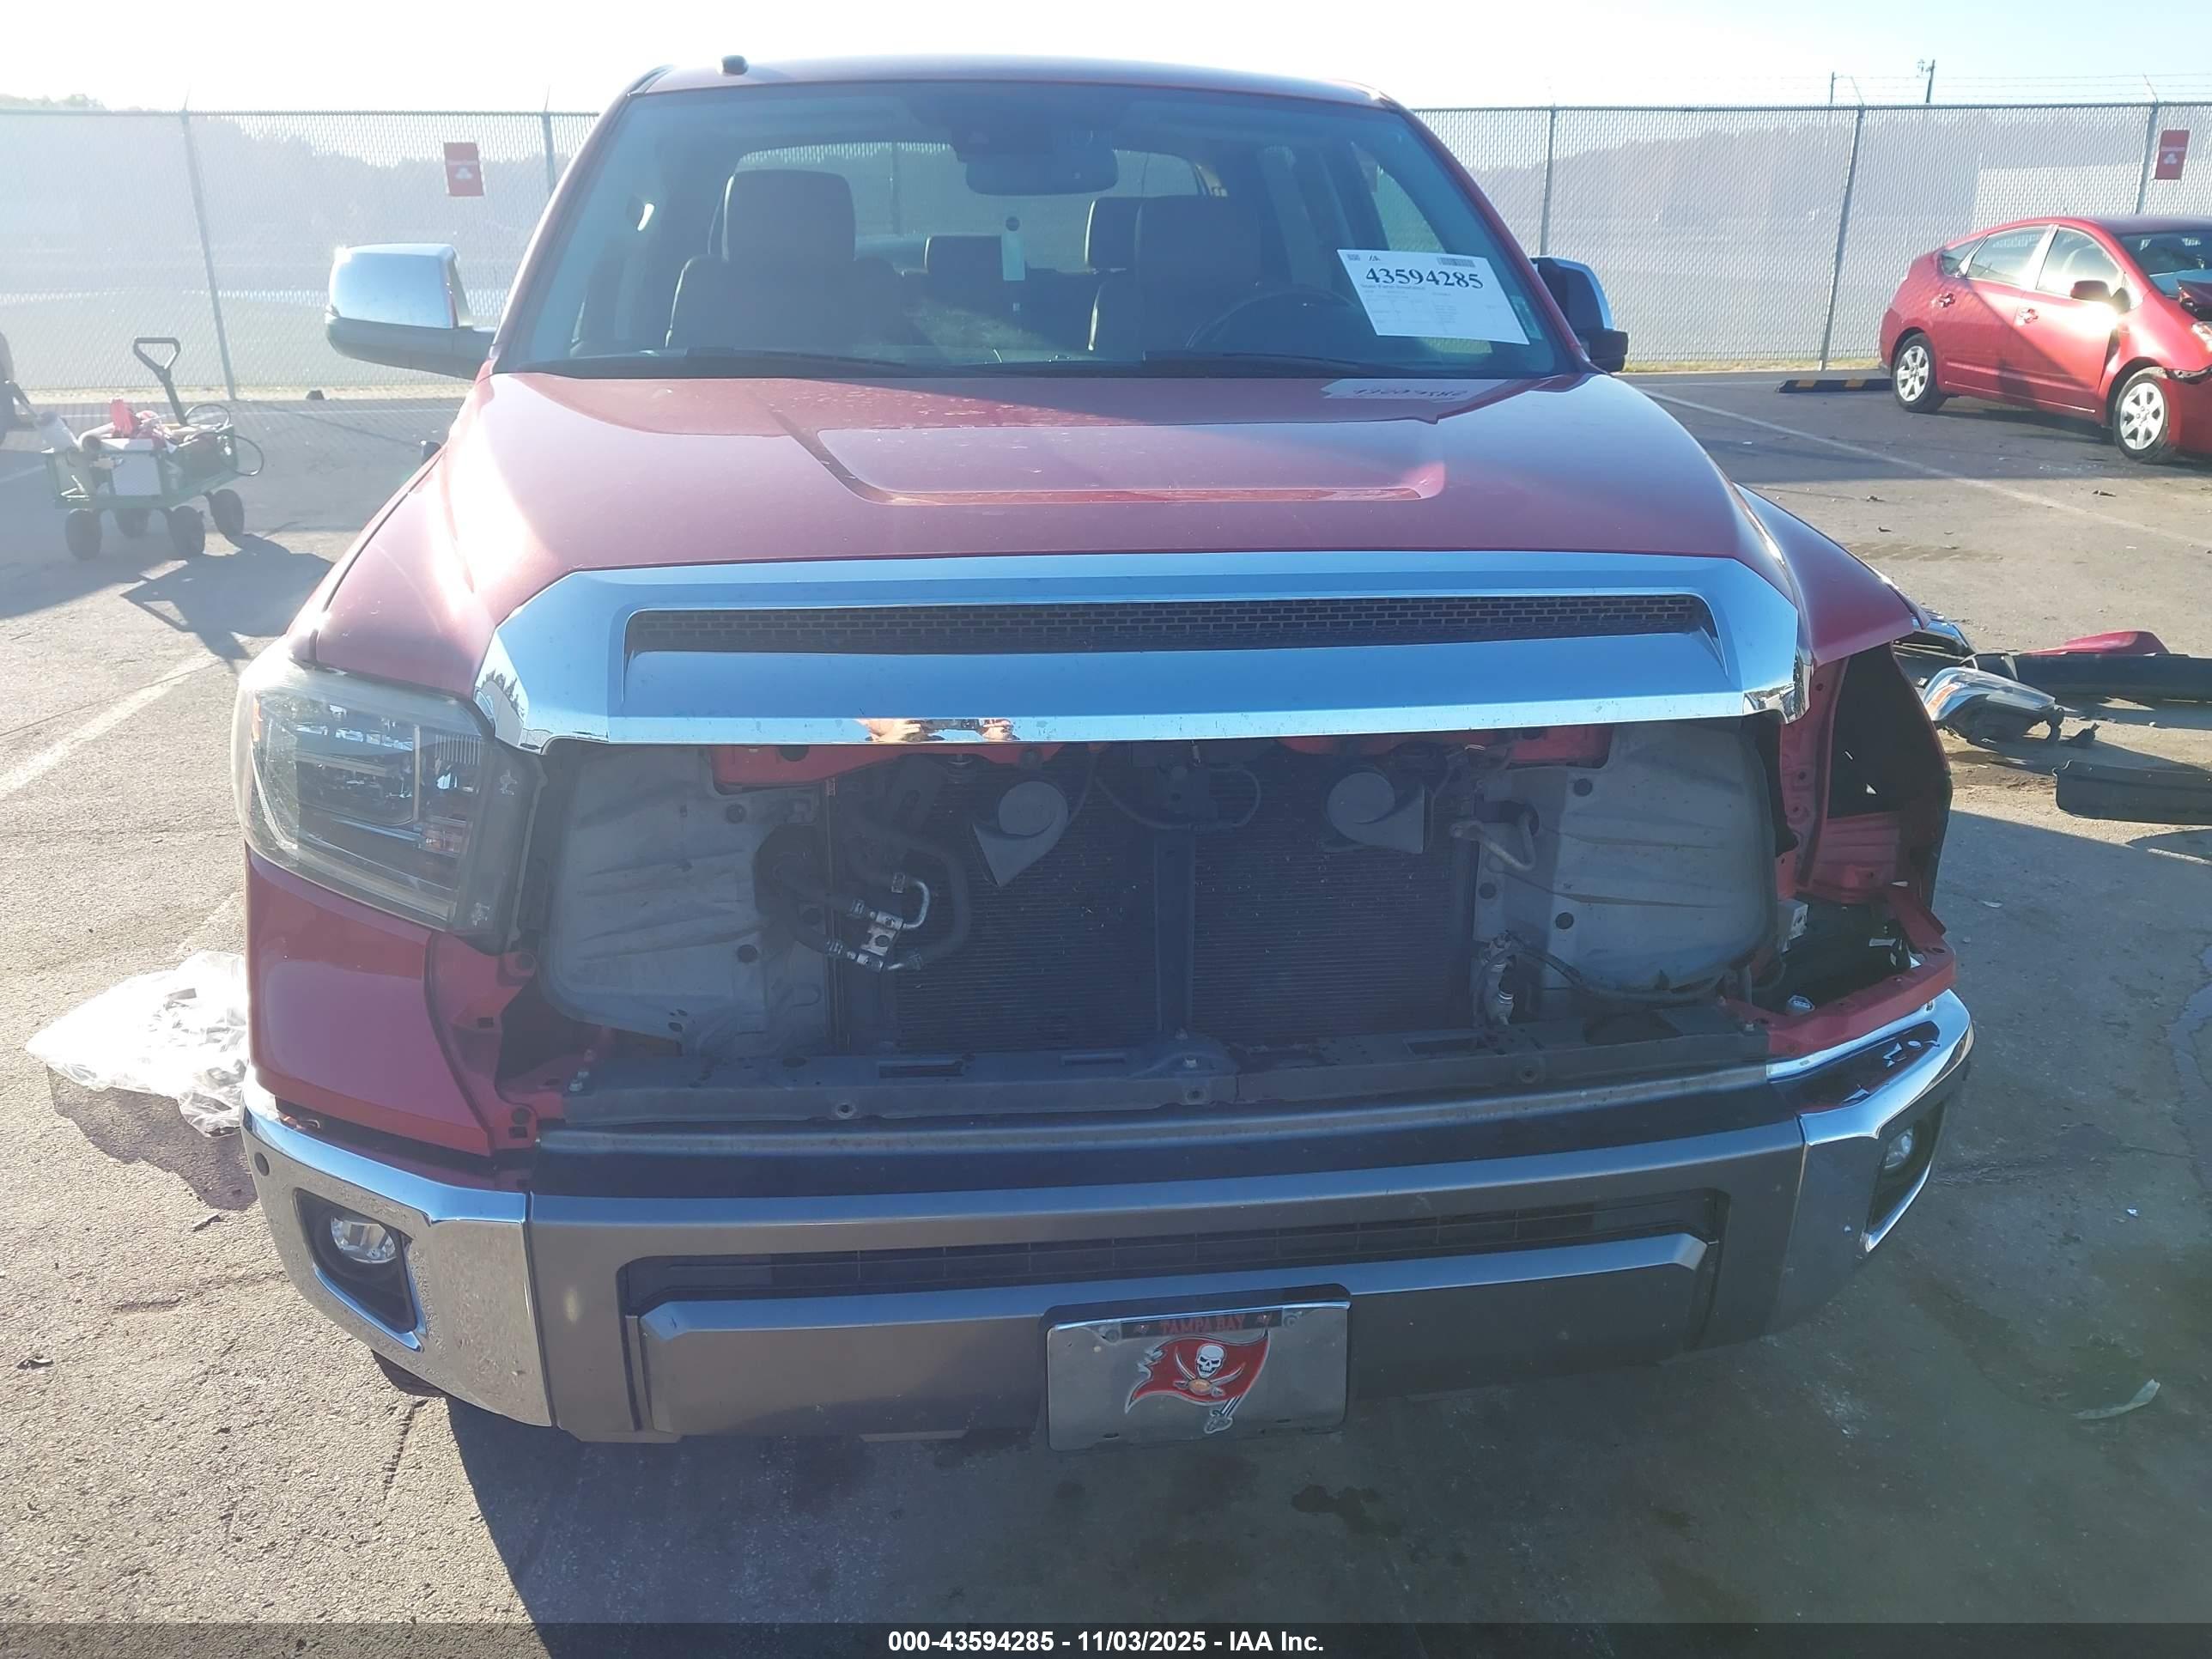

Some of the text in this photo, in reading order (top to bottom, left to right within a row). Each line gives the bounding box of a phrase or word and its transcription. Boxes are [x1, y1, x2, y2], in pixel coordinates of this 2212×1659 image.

[1366, 267, 1484, 289] 43594285
[1161, 1313, 1246, 1334] TAMPA BAY
